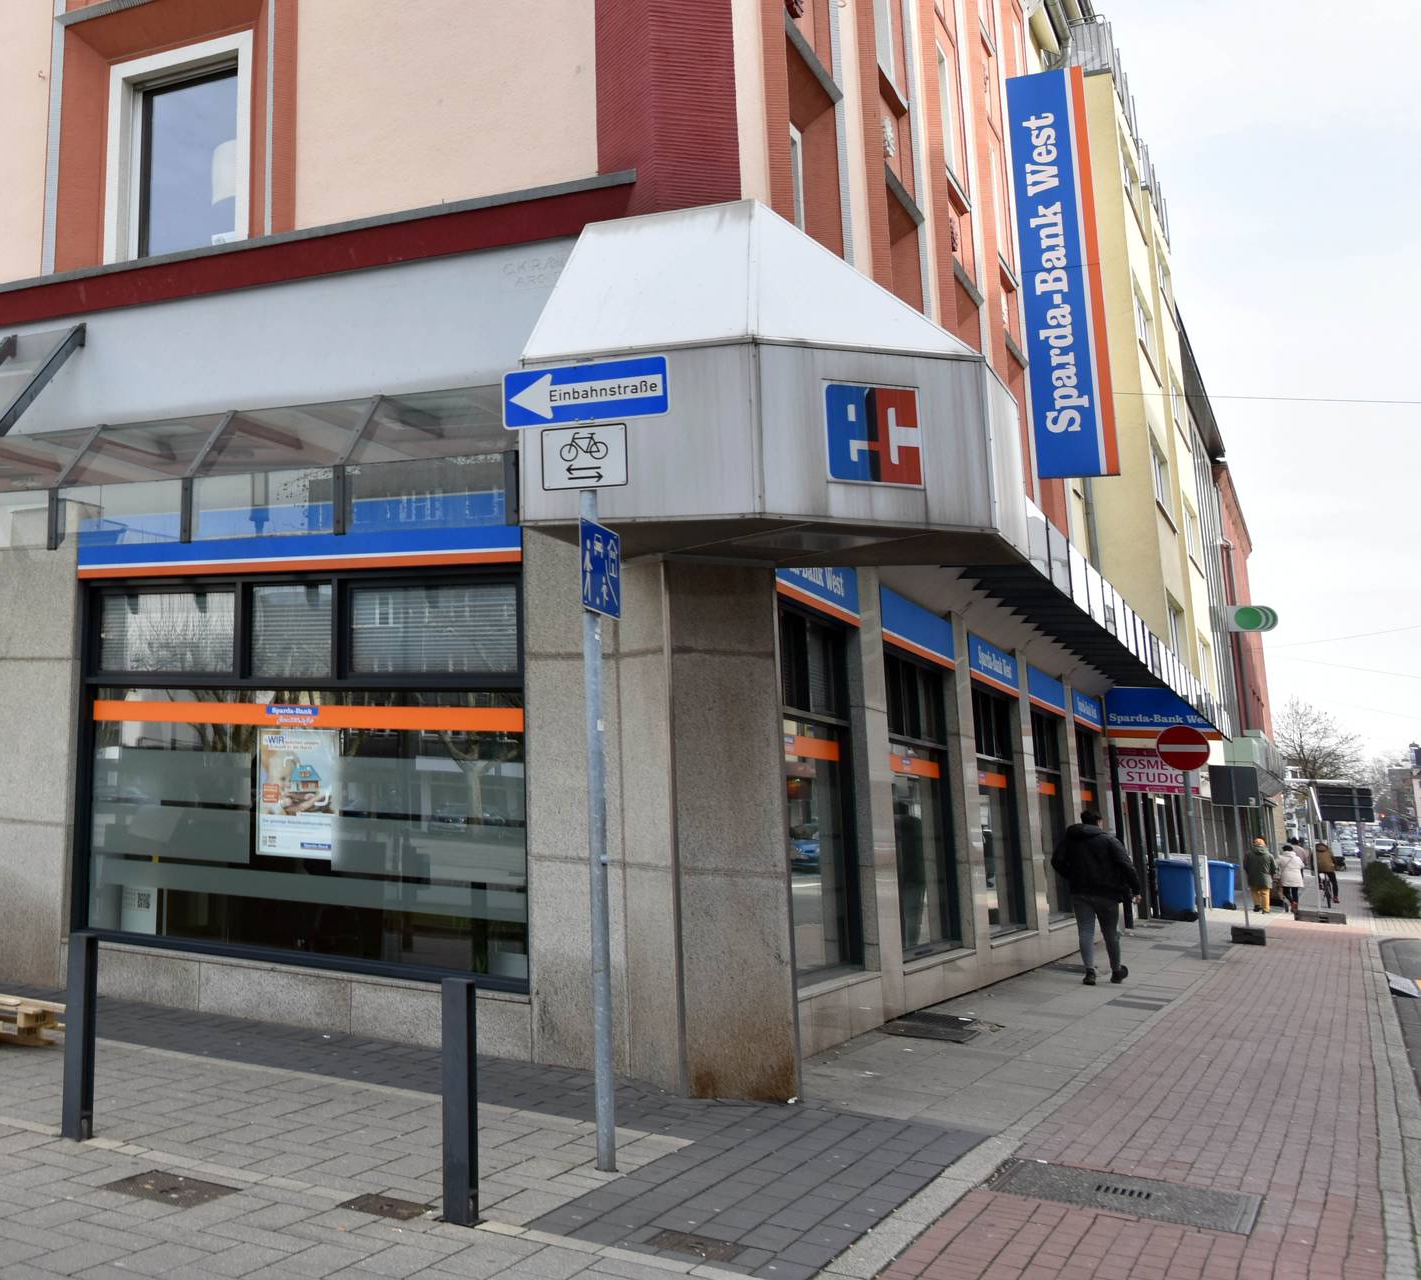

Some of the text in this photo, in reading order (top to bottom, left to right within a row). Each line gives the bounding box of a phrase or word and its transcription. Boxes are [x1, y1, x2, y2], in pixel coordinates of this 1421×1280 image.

[1022, 111, 1090, 434] Sparda-Bank West
[549, 380, 658, 402] Einbahnstraße
[271, 707, 313, 715] Sparda-Bank
[1109, 713, 1207, 724] Sparda-Bank We
[267, 735, 285, 745] WIR
[1127, 771, 1186, 784] STUDIO
